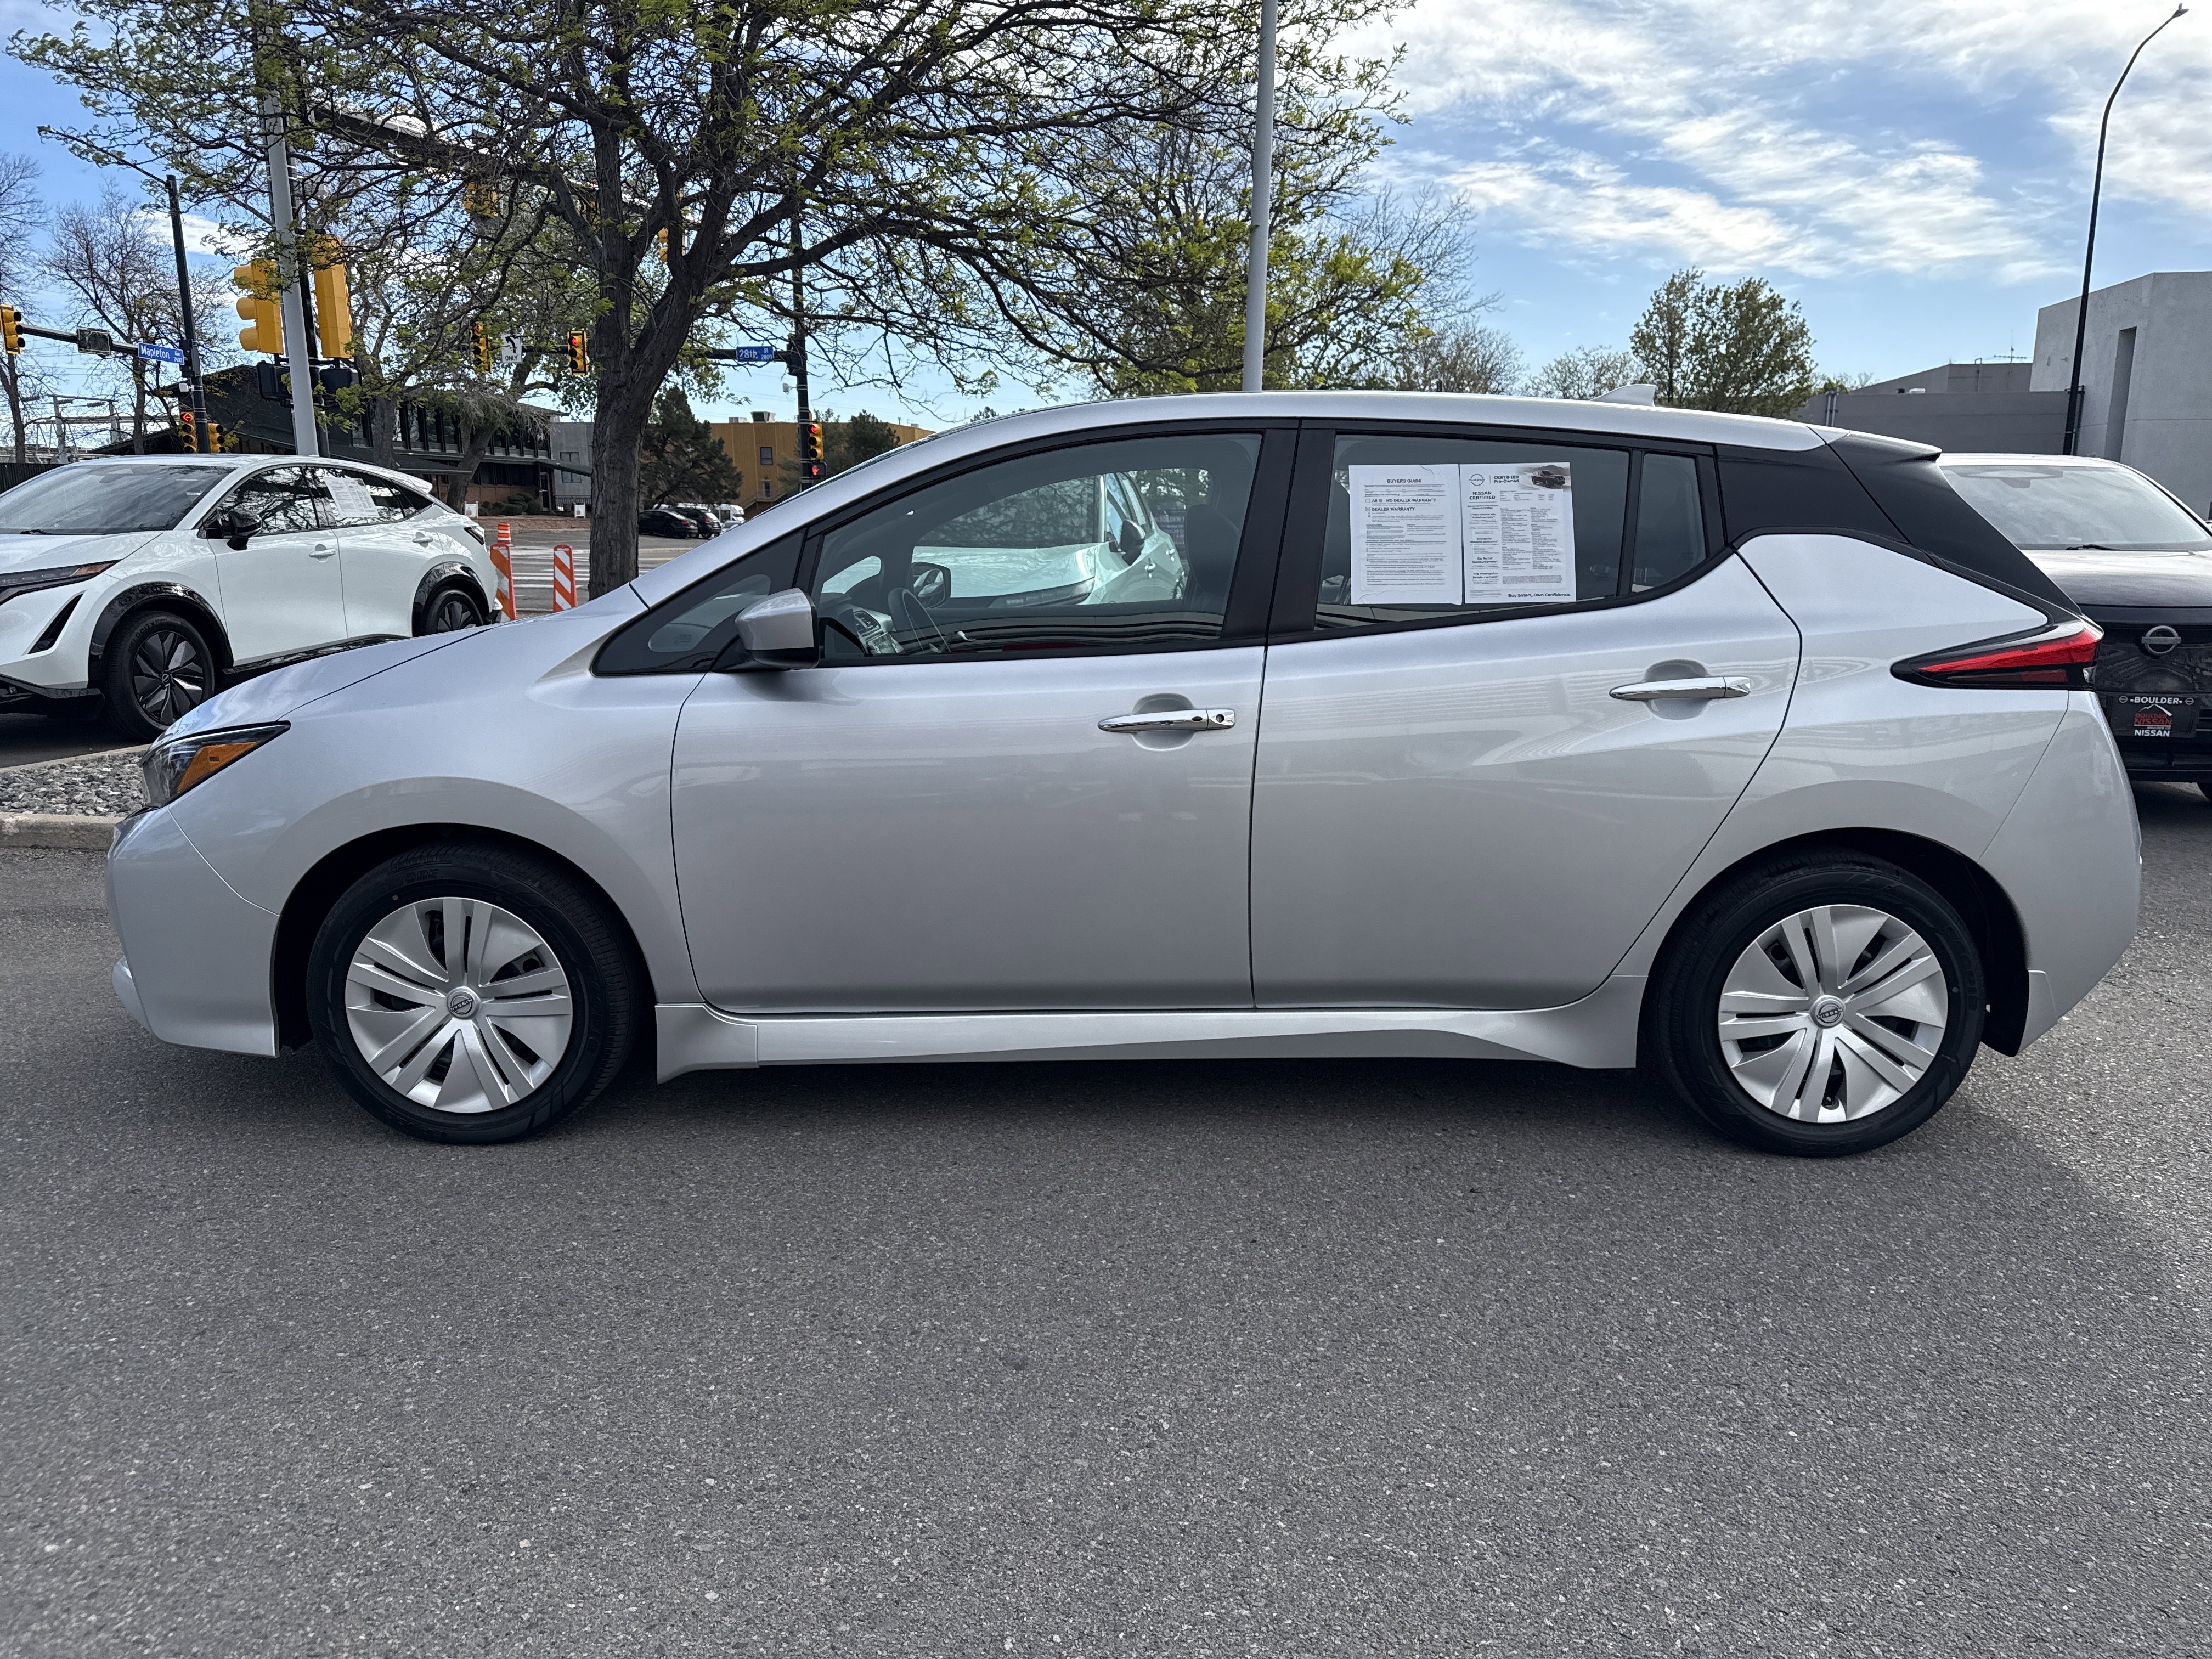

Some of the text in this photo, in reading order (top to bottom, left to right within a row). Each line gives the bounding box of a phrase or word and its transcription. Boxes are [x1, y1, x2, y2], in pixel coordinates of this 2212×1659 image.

[141, 345, 170, 359] Mapleton
[739, 349, 758, 359] 28th
[2134, 696, 2179, 704] BOULDER
[2134, 729, 2170, 737] NISSAN
[450, 998, 473, 1011] NISSAN
[1817, 1008, 1842, 1018] NISSAN
